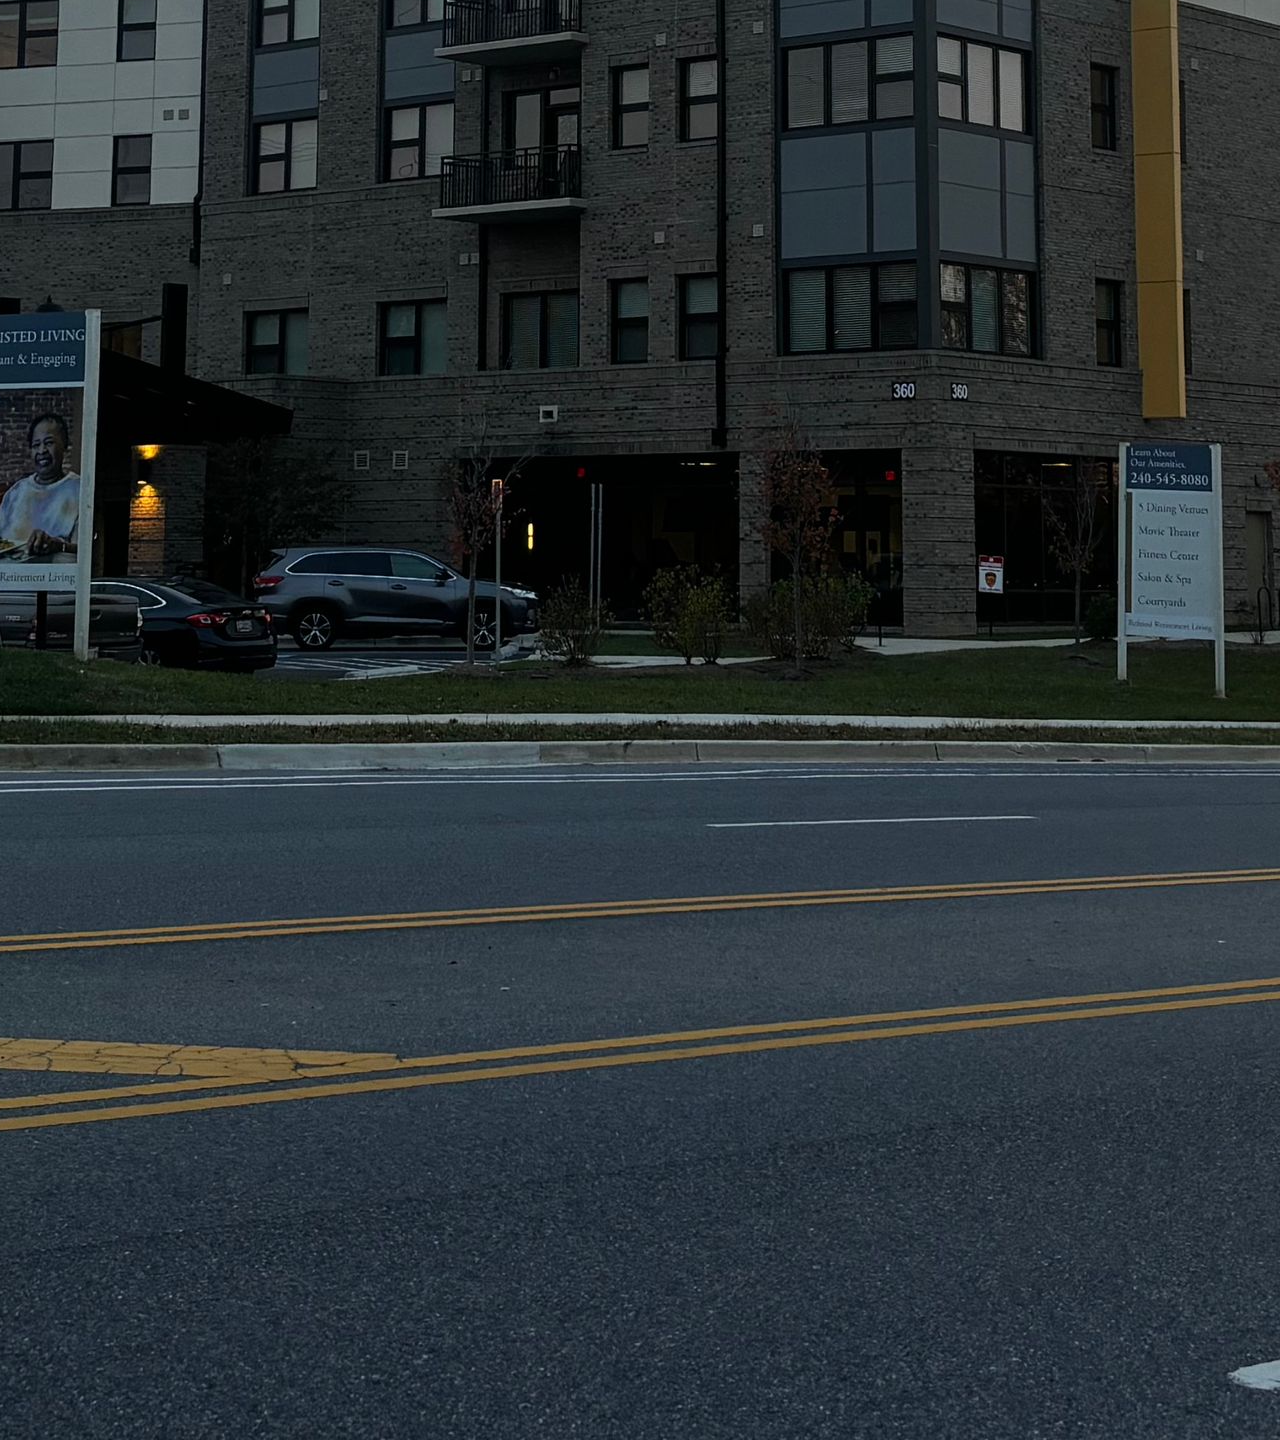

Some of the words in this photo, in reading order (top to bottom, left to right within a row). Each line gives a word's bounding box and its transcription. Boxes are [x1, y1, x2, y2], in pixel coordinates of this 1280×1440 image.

[40, 329, 85, 342] LIVING
[18, 353, 27, 365] &
[31, 352, 76, 368] Engaging
[893, 382, 915, 399] 360
[951, 383, 968, 400] 360
[1130, 447, 1151, 457] Learn
[1153, 448, 1176, 458] About
[1130, 458, 1146, 467] Our
[1130, 472, 1209, 486] 240-545-8080
[1146, 503, 1177, 516] Dining
[1179, 504, 1209, 515] Venues
[1138, 526, 1165, 536] Movie
[1167, 526, 1200, 537] Theater
[1138, 548, 1167, 559] Fitness
[1169, 550, 1199, 561] Center
[0, 571, 45, 582] Retirement
[48, 571, 76, 585] Living
[1138, 571, 1162, 583] Salon
[1164, 574, 1173, 583] &
[1175, 573, 1192, 587] Spa
[1137, 594, 1186, 609] Courtyards
